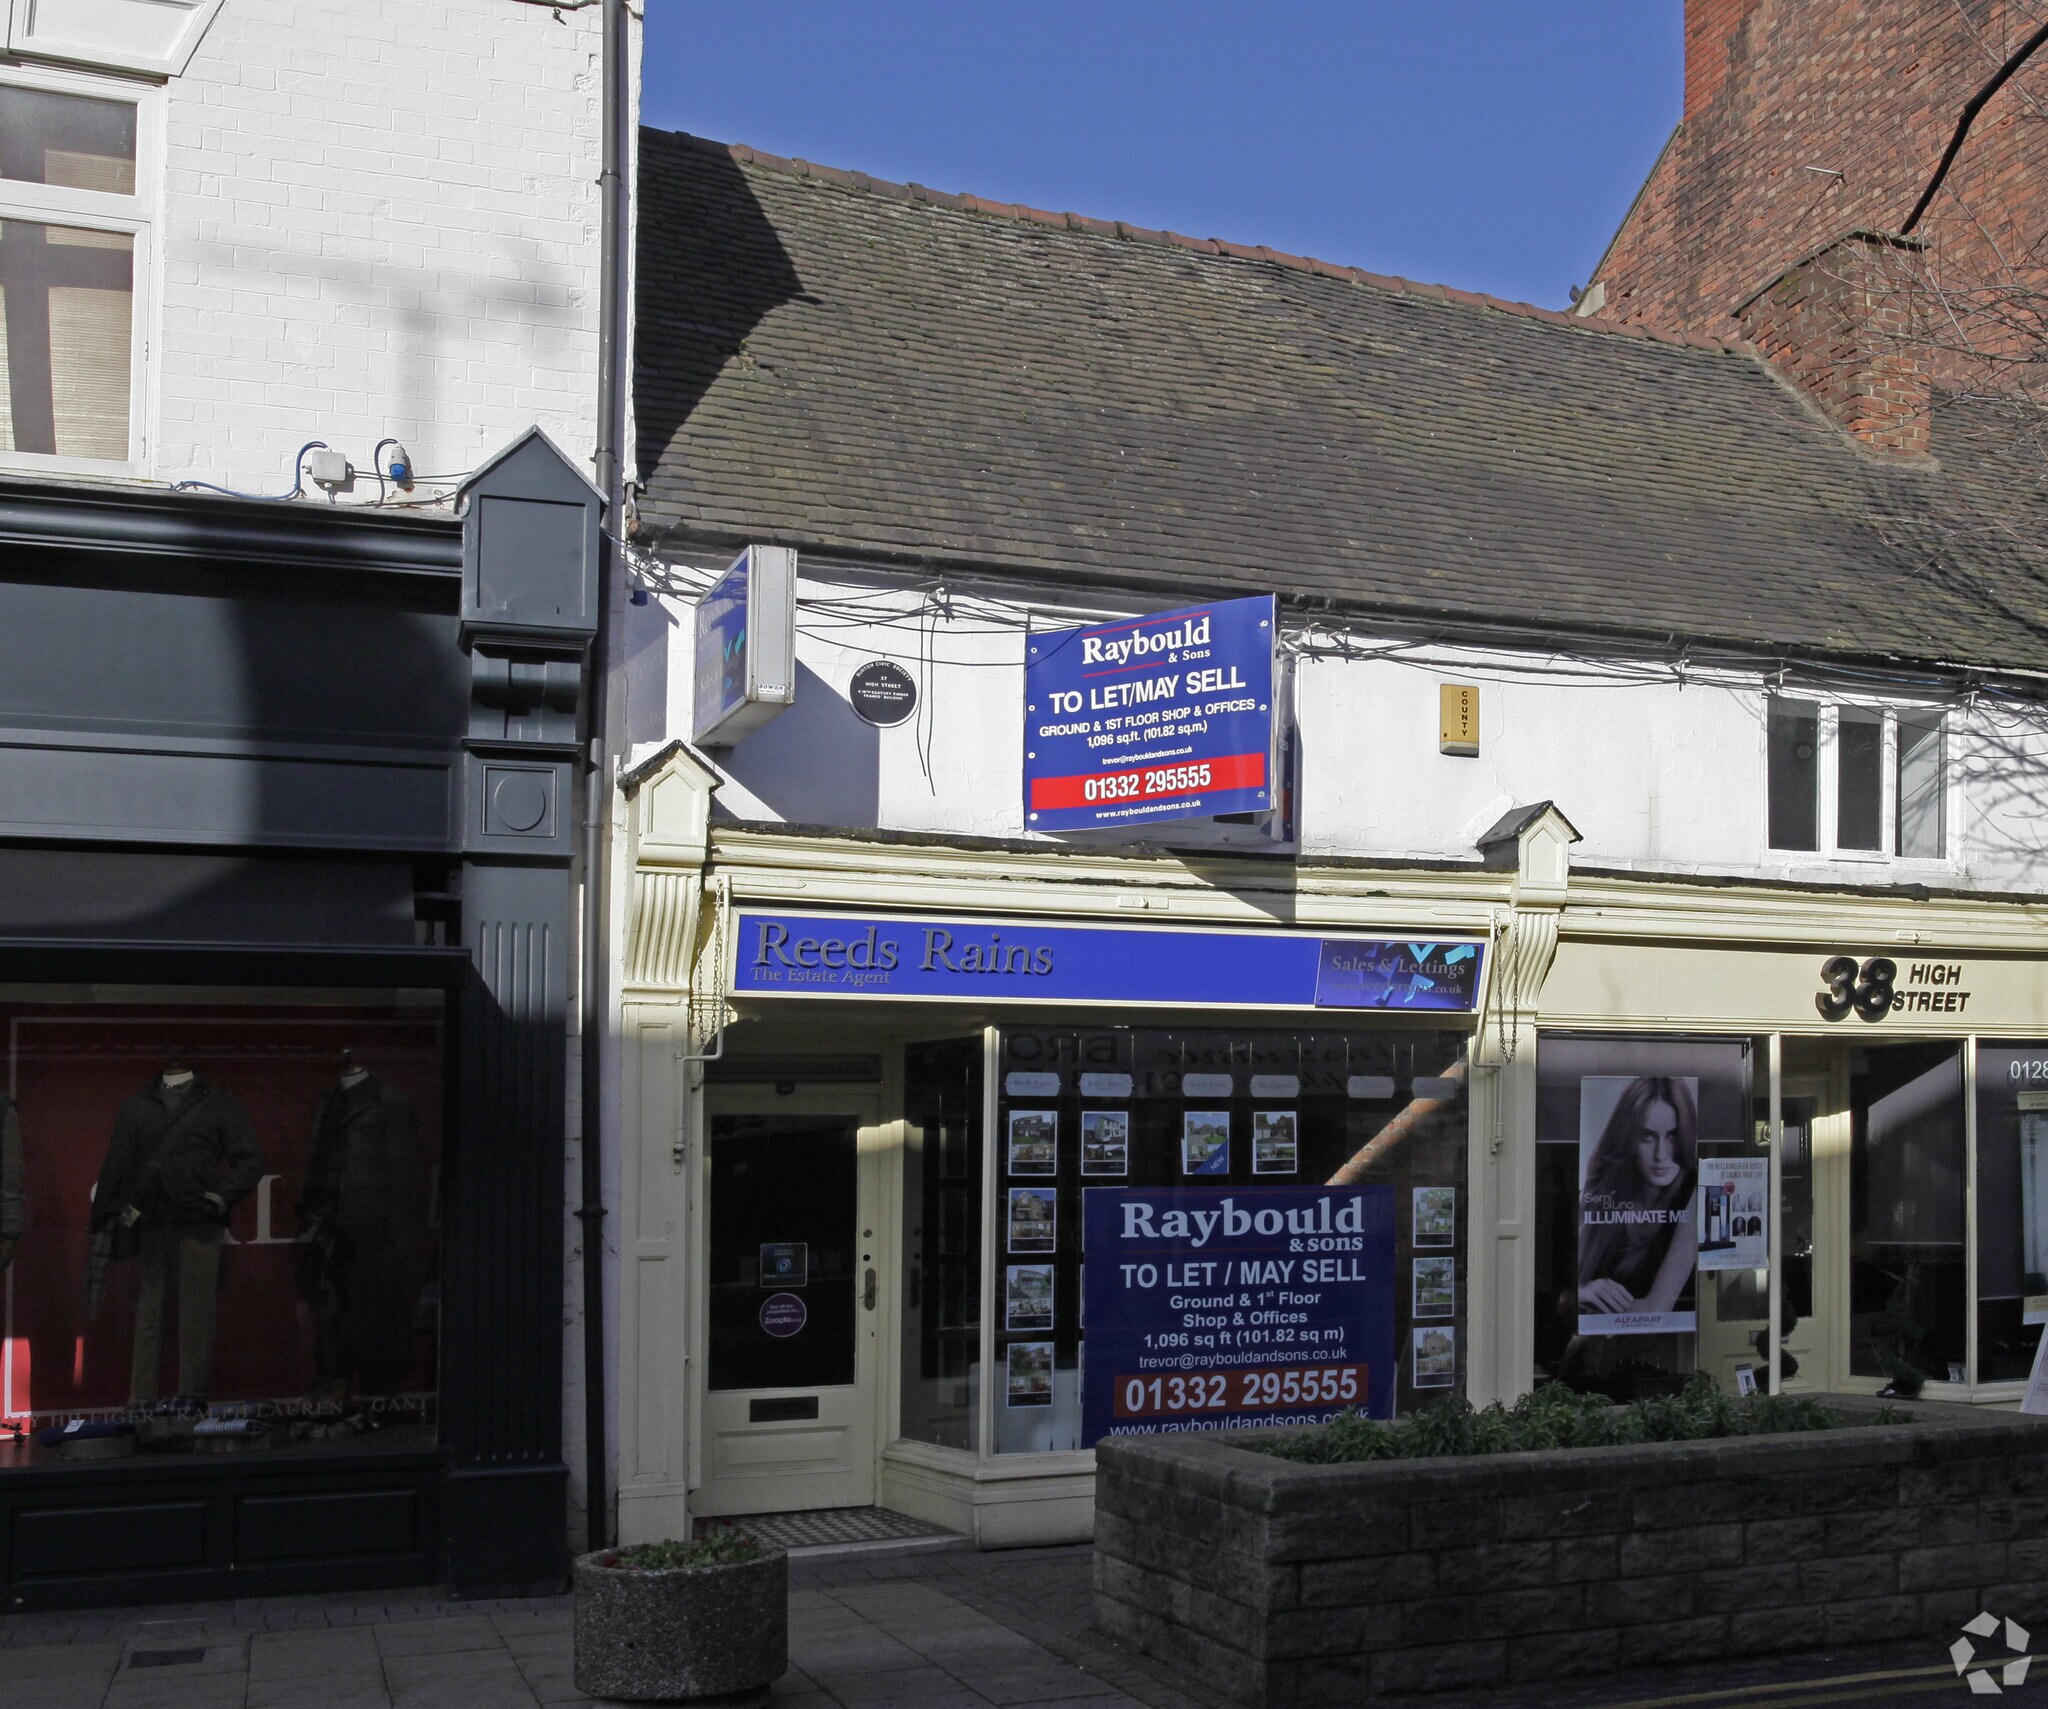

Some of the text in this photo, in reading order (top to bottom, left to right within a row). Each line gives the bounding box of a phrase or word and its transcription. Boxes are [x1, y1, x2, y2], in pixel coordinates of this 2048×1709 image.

[1082, 616, 1211, 665] Raybould
[1168, 648, 1211, 664] & Sons
[892, 664, 912, 682] SOCIETY
[1049, 666, 1246, 714] TO LET/MAY SELL
[1039, 699, 1255, 737] GROUND & 1ST FLOOR SHOP & OFFICES
[1087, 736, 1114, 749] 1,096
[1143, 725, 1175, 742] (101.82
[1084, 764, 1211, 800] 01332 295555
[1096, 800, 1201, 819] www.raybouldandsons.co.uk
[754, 921, 1054, 975] Reeds Rains
[752, 966, 891, 988] The Estate Agent
[1332, 956, 1465, 979] Sales & Lettings
[1909, 964, 1962, 986] HIGH
[1815, 956, 1897, 1023] 38
[1891, 991, 1970, 1012] STREET
[1210, 1155, 1225, 1170] NEW
[1120, 1196, 1365, 1248] Raybould
[1584, 1210, 1690, 1224] ILLUMINATE ME
[1289, 1234, 1363, 1252] & sons
[1120, 1258, 1366, 1288] TO LET / MAY SELL
[1170, 1290, 1321, 1309] Ground & 1st Floor
[1183, 1311, 1308, 1329] Shop & Offices
[1614, 1315, 1663, 1324] ALFAPARF
[1144, 1326, 1344, 1349] 1,096 sq ft (101.82 sq m)
[1139, 1347, 1347, 1370] trevor@raybouldandsons.co.uk
[1125, 1368, 1358, 1412] 01332 295555
[258, 1400, 344, 1418] LAUREN
[371, 1398, 428, 1412] GANT
